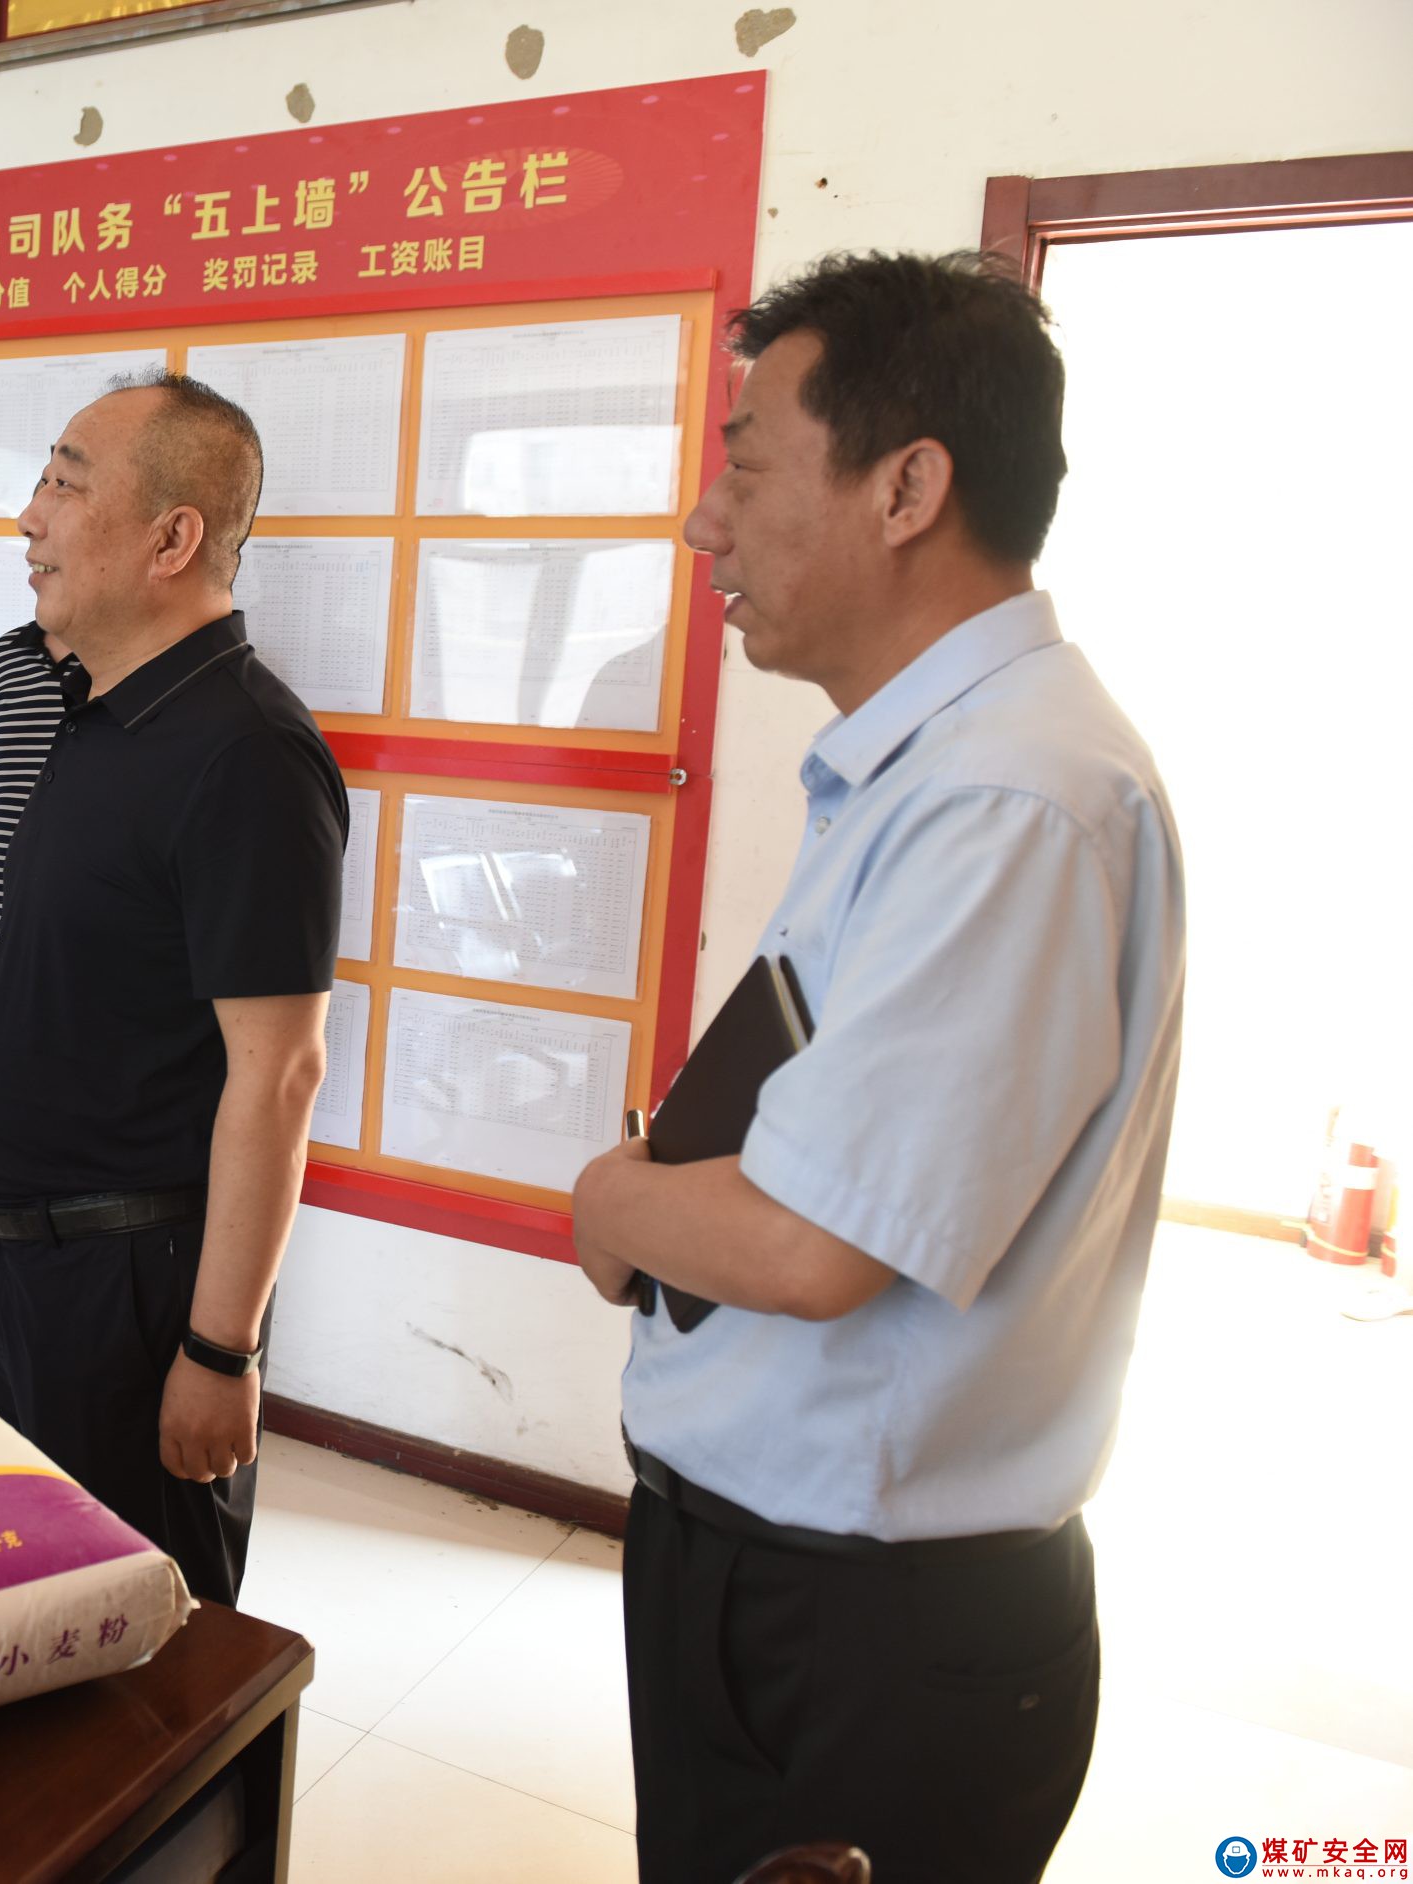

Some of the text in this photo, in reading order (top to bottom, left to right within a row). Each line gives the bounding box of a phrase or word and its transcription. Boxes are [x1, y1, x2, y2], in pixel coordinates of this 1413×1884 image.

[62, 264, 167, 304] 个人得分
[203, 250, 319, 292] 奖罚记录
[358, 235, 486, 278] 工资账目
